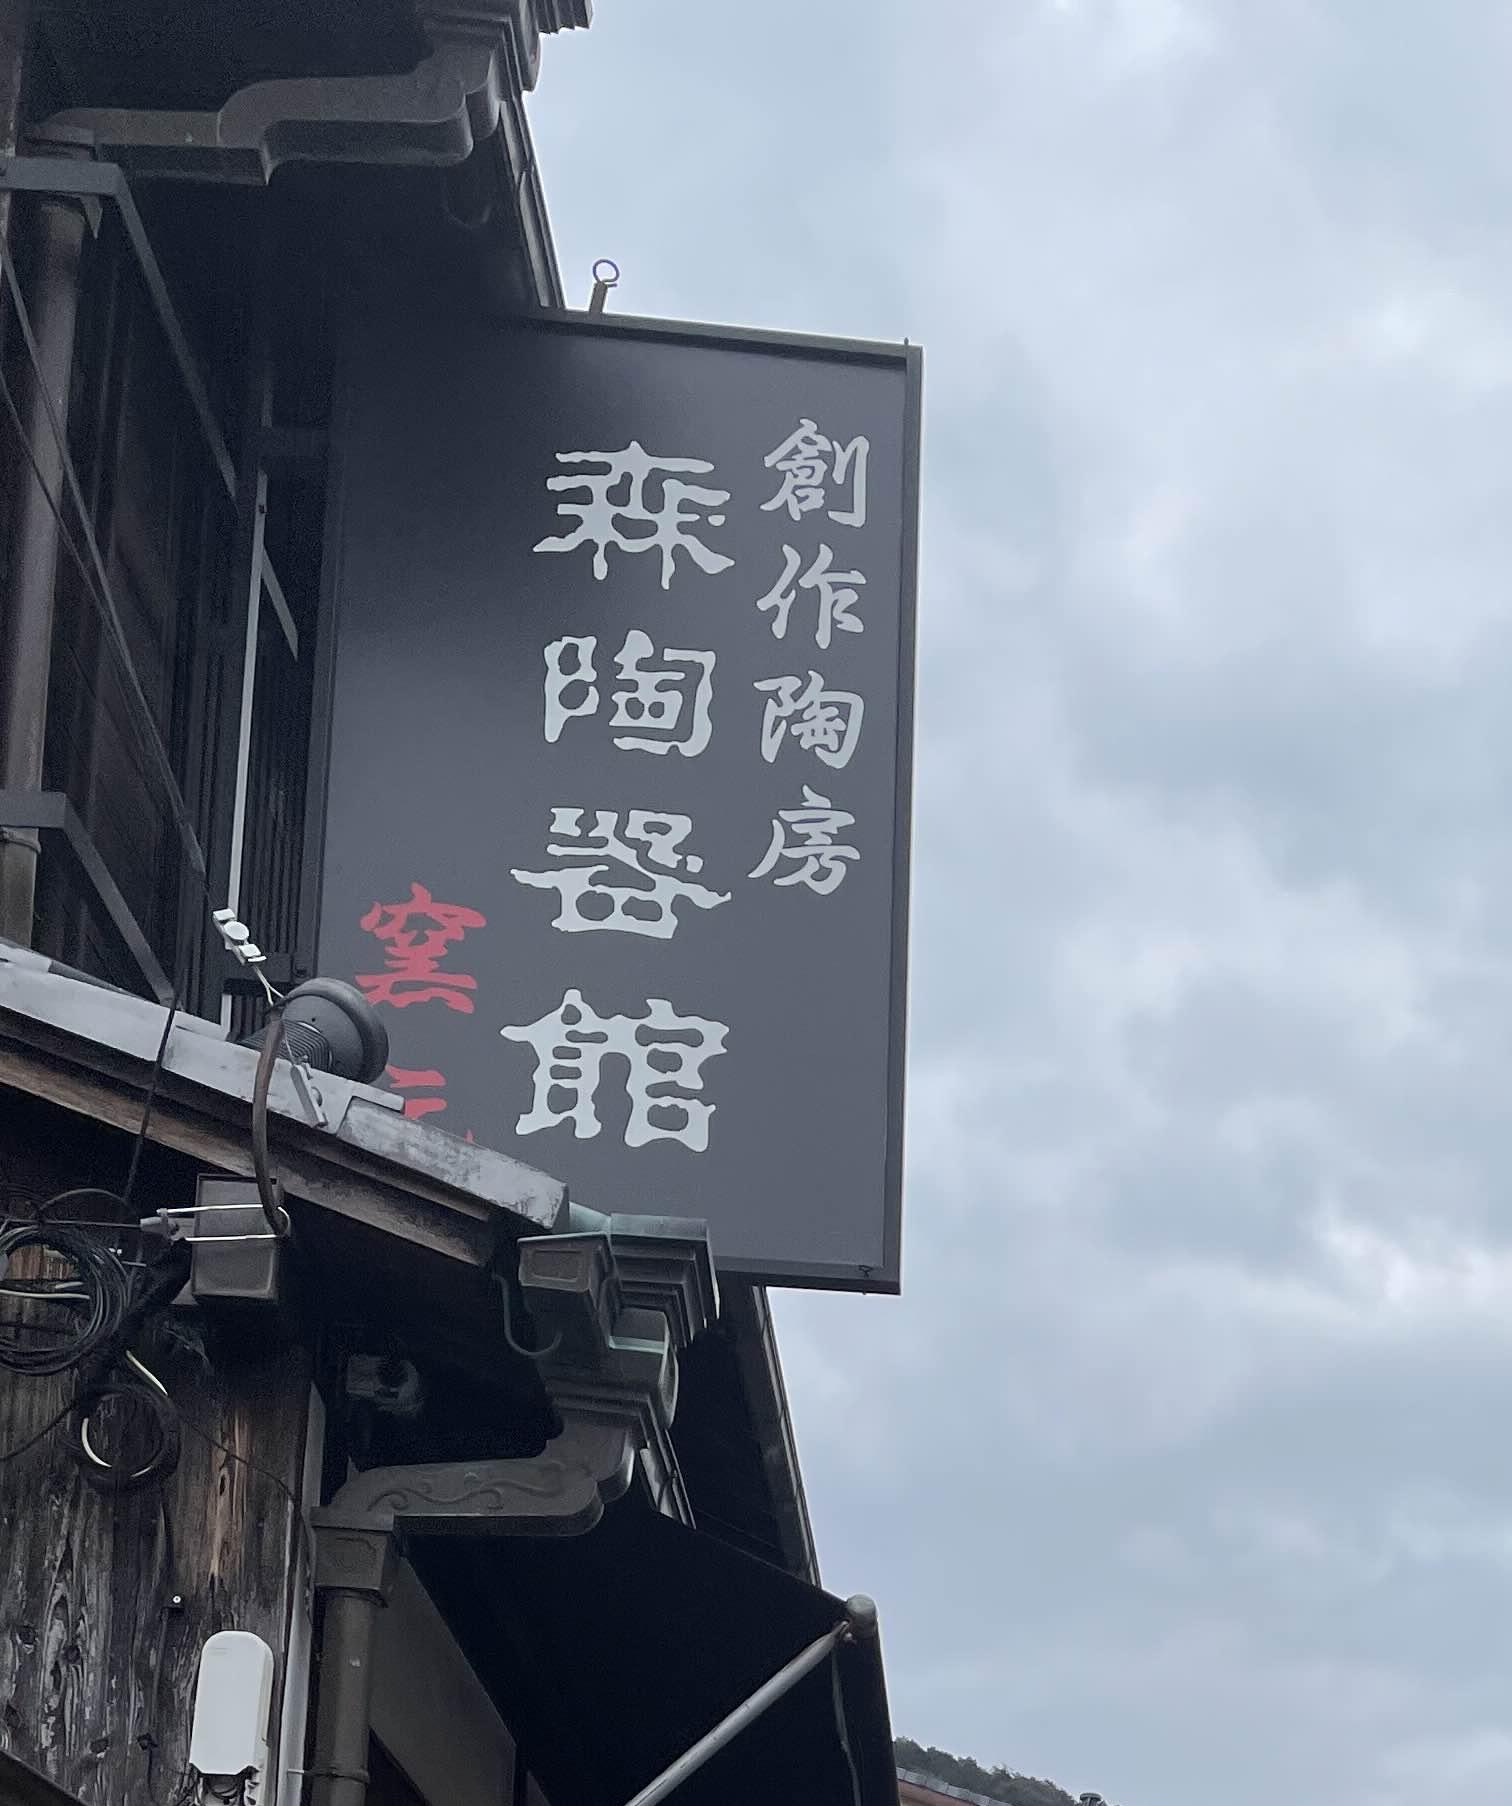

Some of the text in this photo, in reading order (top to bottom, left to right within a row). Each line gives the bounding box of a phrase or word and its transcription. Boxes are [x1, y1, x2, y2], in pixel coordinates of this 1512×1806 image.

[500, 441, 735, 1153] 森陶器館
[749, 419, 870, 895] 創作陶房
